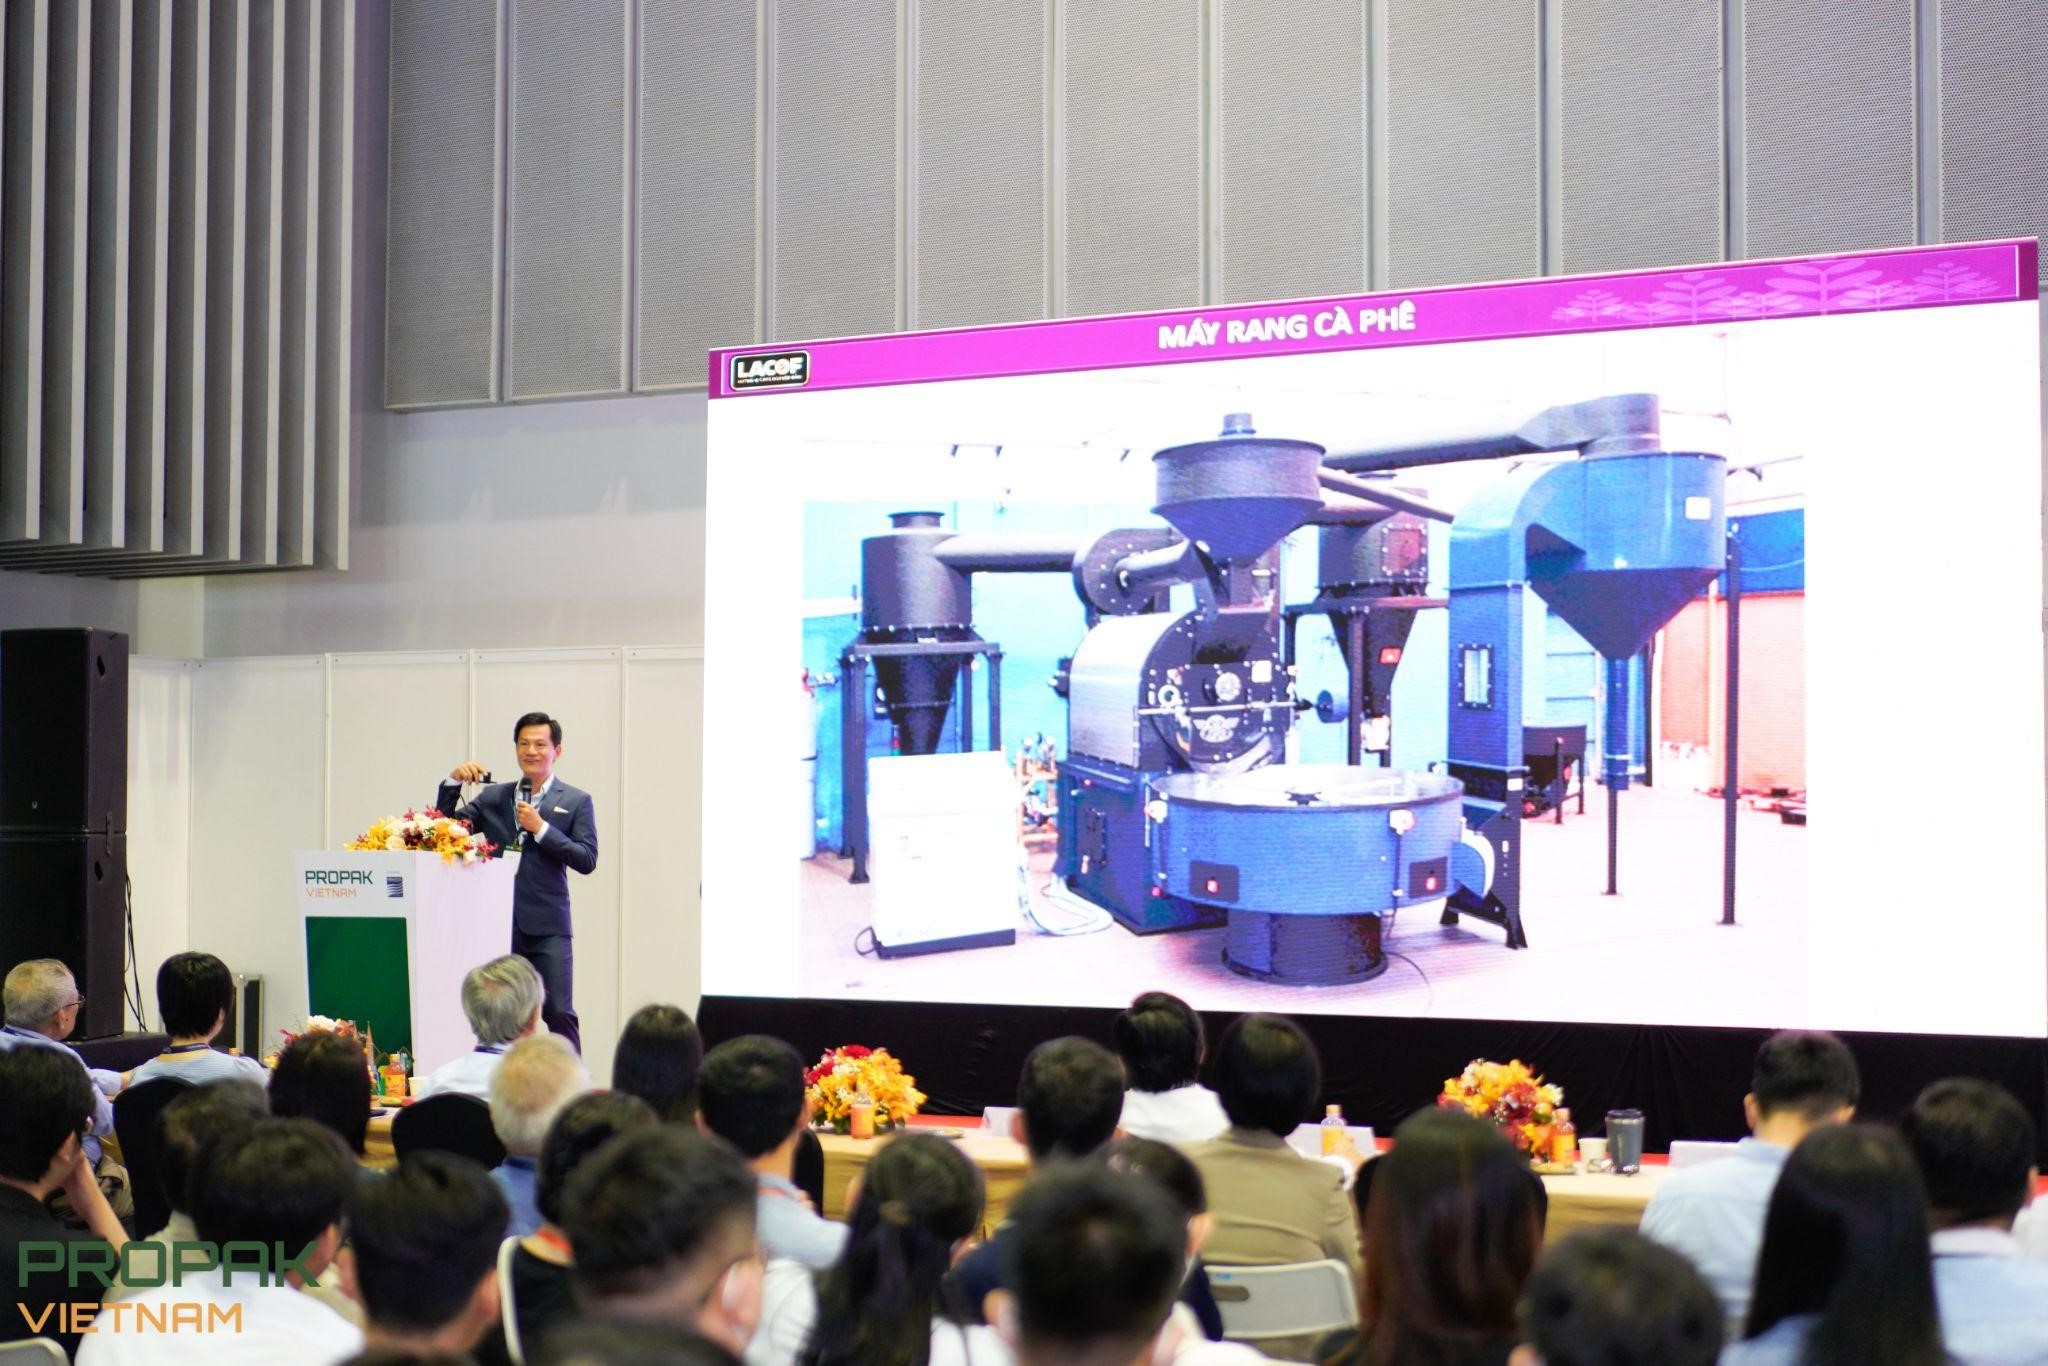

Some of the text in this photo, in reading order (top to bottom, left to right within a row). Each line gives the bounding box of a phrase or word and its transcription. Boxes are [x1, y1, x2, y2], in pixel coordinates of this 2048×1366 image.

[1158, 299, 1417, 349] MÁY RANG CÀ PHÊ
[737, 356, 804, 379] LACOF
[305, 870, 373, 885] PROPAK
[306, 888, 357, 897] VIETNAM
